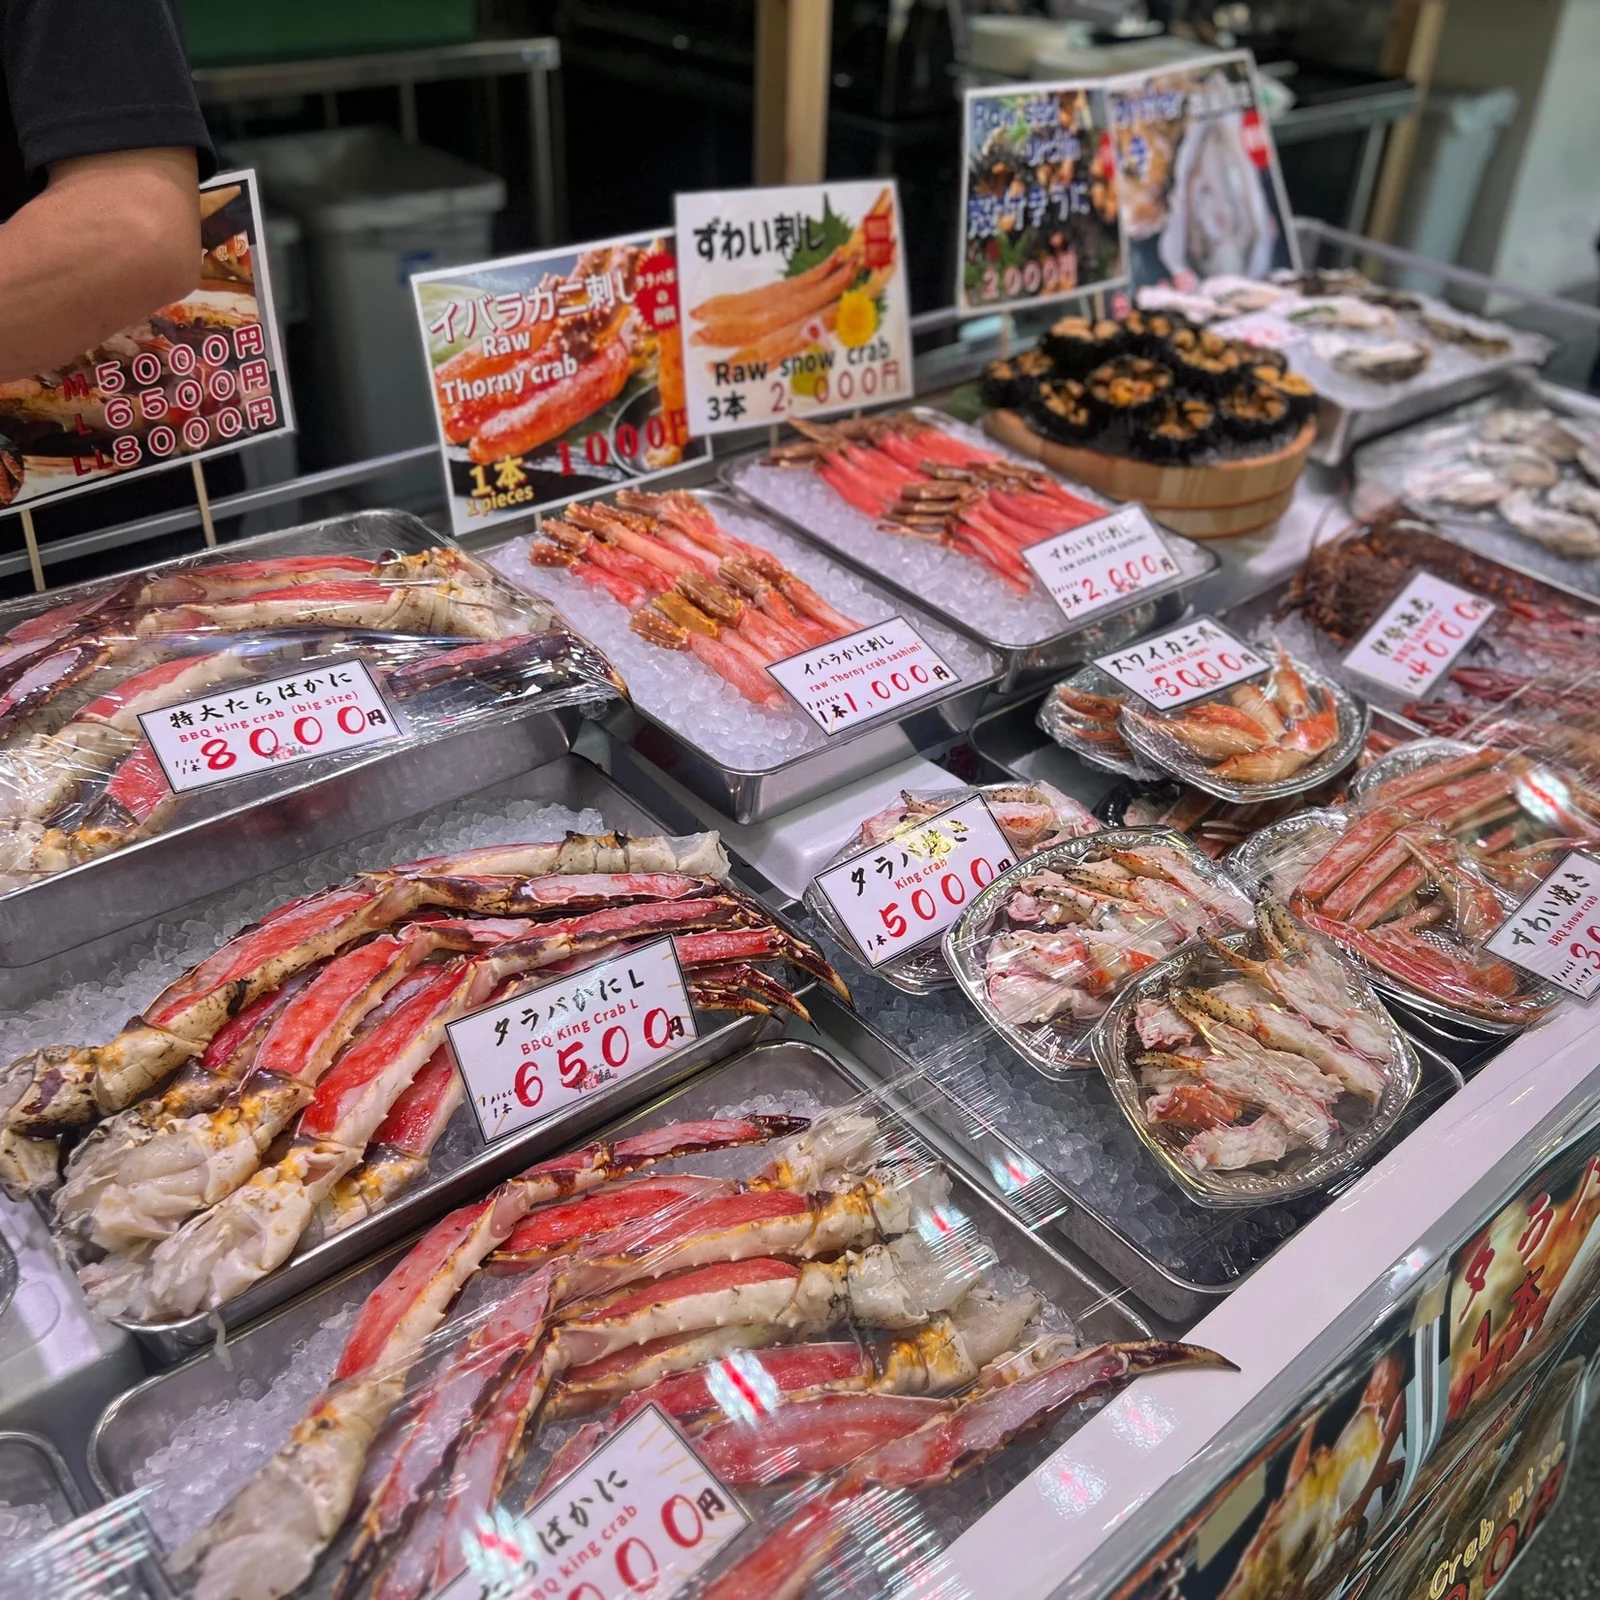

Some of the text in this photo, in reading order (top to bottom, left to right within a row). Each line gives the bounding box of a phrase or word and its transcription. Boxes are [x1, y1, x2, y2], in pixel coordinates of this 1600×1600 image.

[693, 212, 825, 263] ずわい刺し
[64, 323, 264, 401] M 5000円
[482, 332, 532, 358] Raw
[715, 338, 891, 386] Raw snow crab
[75, 359, 271, 437] L 6500円
[441, 354, 578, 405] Thorny crab
[707, 391, 746, 422] 3本
[469, 455, 528, 498] 1本
[482, 484, 534, 513] pieces
[804, 634, 894, 676] イバラかに刺し
[810, 641, 923, 693] raw Thorny crab sashimi
[170, 672, 352, 729] 特大たらばかに
[179, 690, 359, 743] BBQ king crab (big size)
[894, 872, 923, 891] King
[1548, 895, 1599, 946] BBQ Snow crab
[521, 999, 639, 1055] BBQ King Crab L
[559, 1539, 603, 1580] king
[602, 1504, 638, 1541] crab
[1429, 1517, 1495, 1600] Crab
